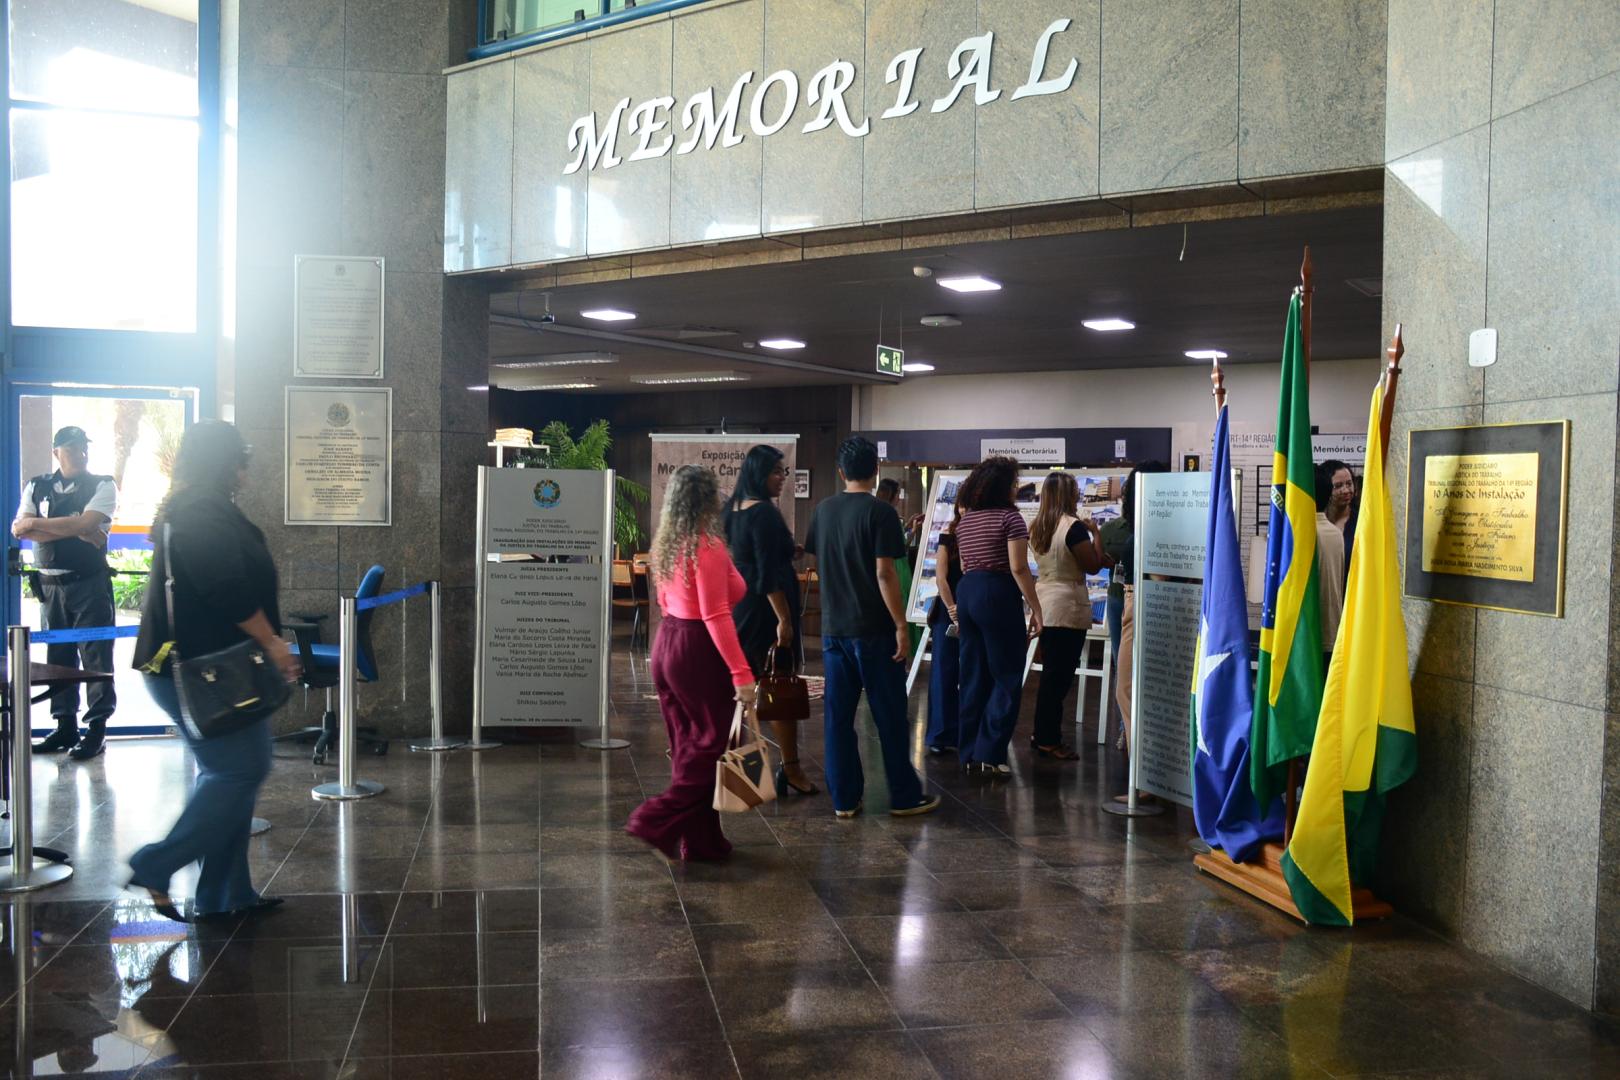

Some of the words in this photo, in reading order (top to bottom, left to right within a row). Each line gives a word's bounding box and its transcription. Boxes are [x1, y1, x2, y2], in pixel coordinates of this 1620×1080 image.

[562, 18, 1078, 174] MEMORIAL
[1253, 432, 1276, 442] REGIÃO
[988, 447, 1020, 455] Memórias
[1021, 447, 1057, 455] Cartorárias
[1313, 444, 1354, 453] Memórias
[702, 450, 746, 464] Exposição
[1443, 488, 1464, 498] Anos
[1466, 489, 1475, 498] de
[1478, 487, 1525, 501] Instalação
